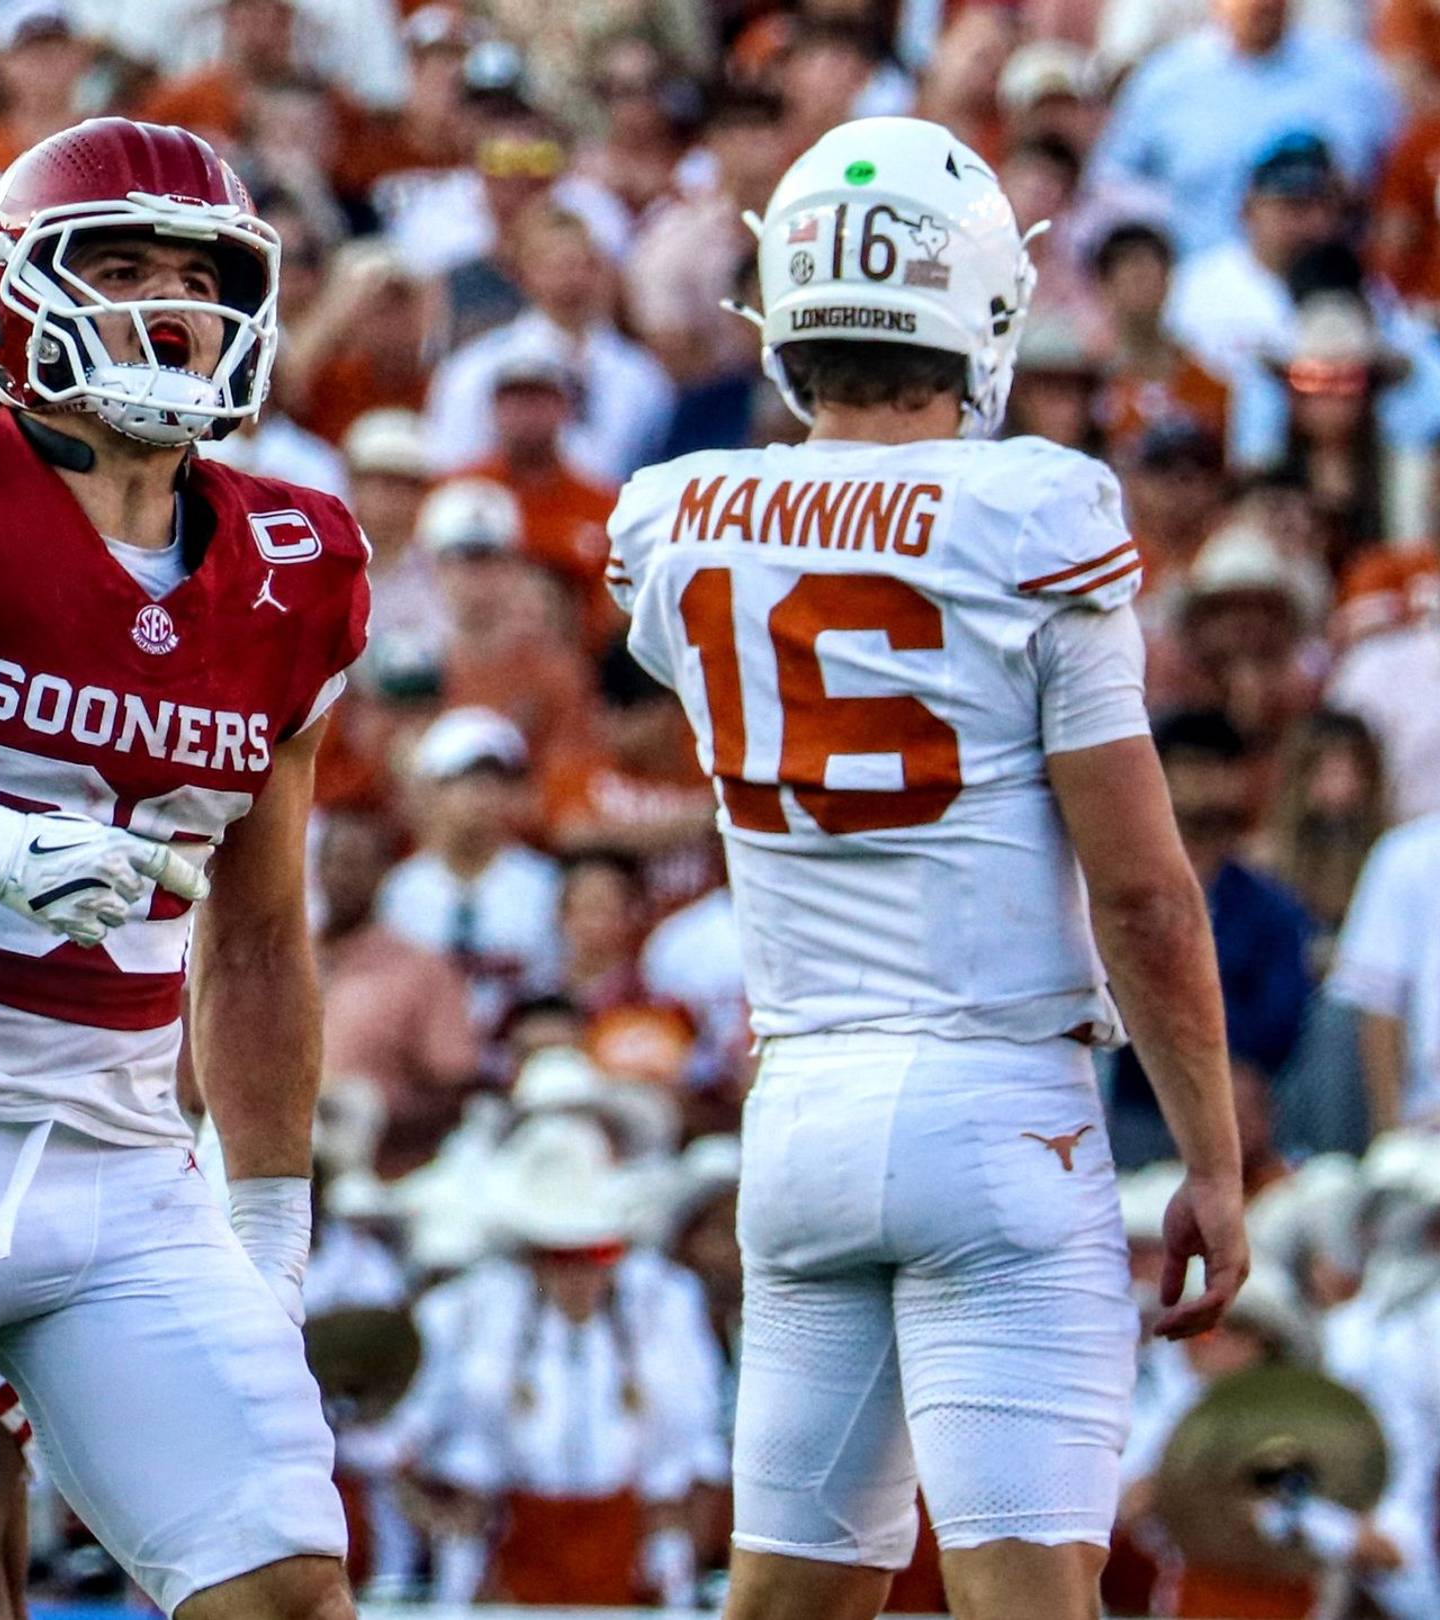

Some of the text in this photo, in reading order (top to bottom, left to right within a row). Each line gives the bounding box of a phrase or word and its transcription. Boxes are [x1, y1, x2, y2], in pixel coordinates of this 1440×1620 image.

[832, 203, 897, 281] 16
[791, 306, 917, 333] LONGHORNS
[249, 510, 321, 563] C
[670, 475, 944, 558] MANNING
[138, 606, 171, 643] SEC
[678, 567, 963, 835] 16
